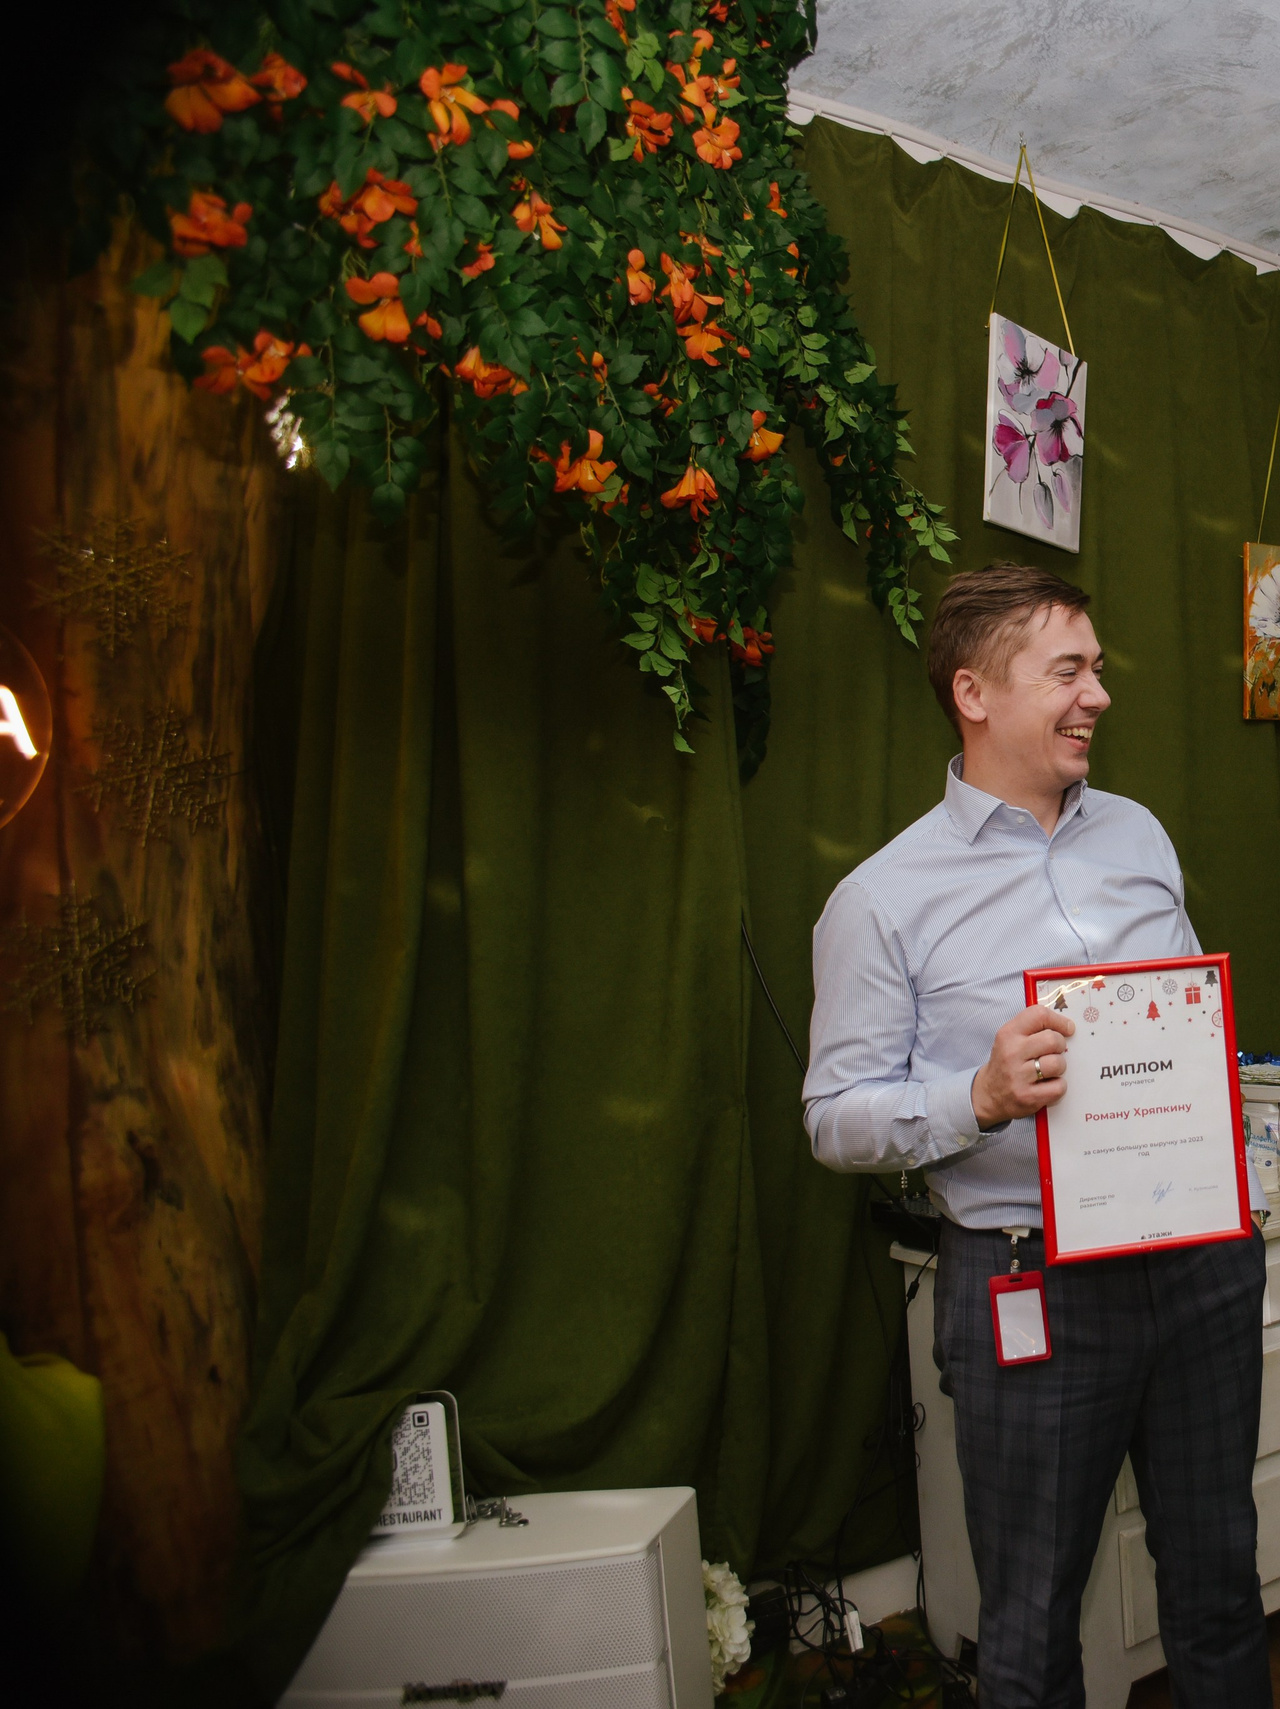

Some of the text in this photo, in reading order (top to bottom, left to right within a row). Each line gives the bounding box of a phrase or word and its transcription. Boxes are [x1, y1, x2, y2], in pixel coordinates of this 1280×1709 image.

[1100, 1059, 1173, 1079] ДИПЛОМ
[1121, 1078, 1155, 1087] вручается
[1085, 1103, 1192, 1122] Роману Хряпкину
[1092, 1147, 1115, 1155] самую
[1116, 1143, 1148, 1151] большую
[1149, 1139, 1178, 1147] выручку
[1079, 1195, 1107, 1203] Директор
[1080, 1201, 1107, 1209] развитию
